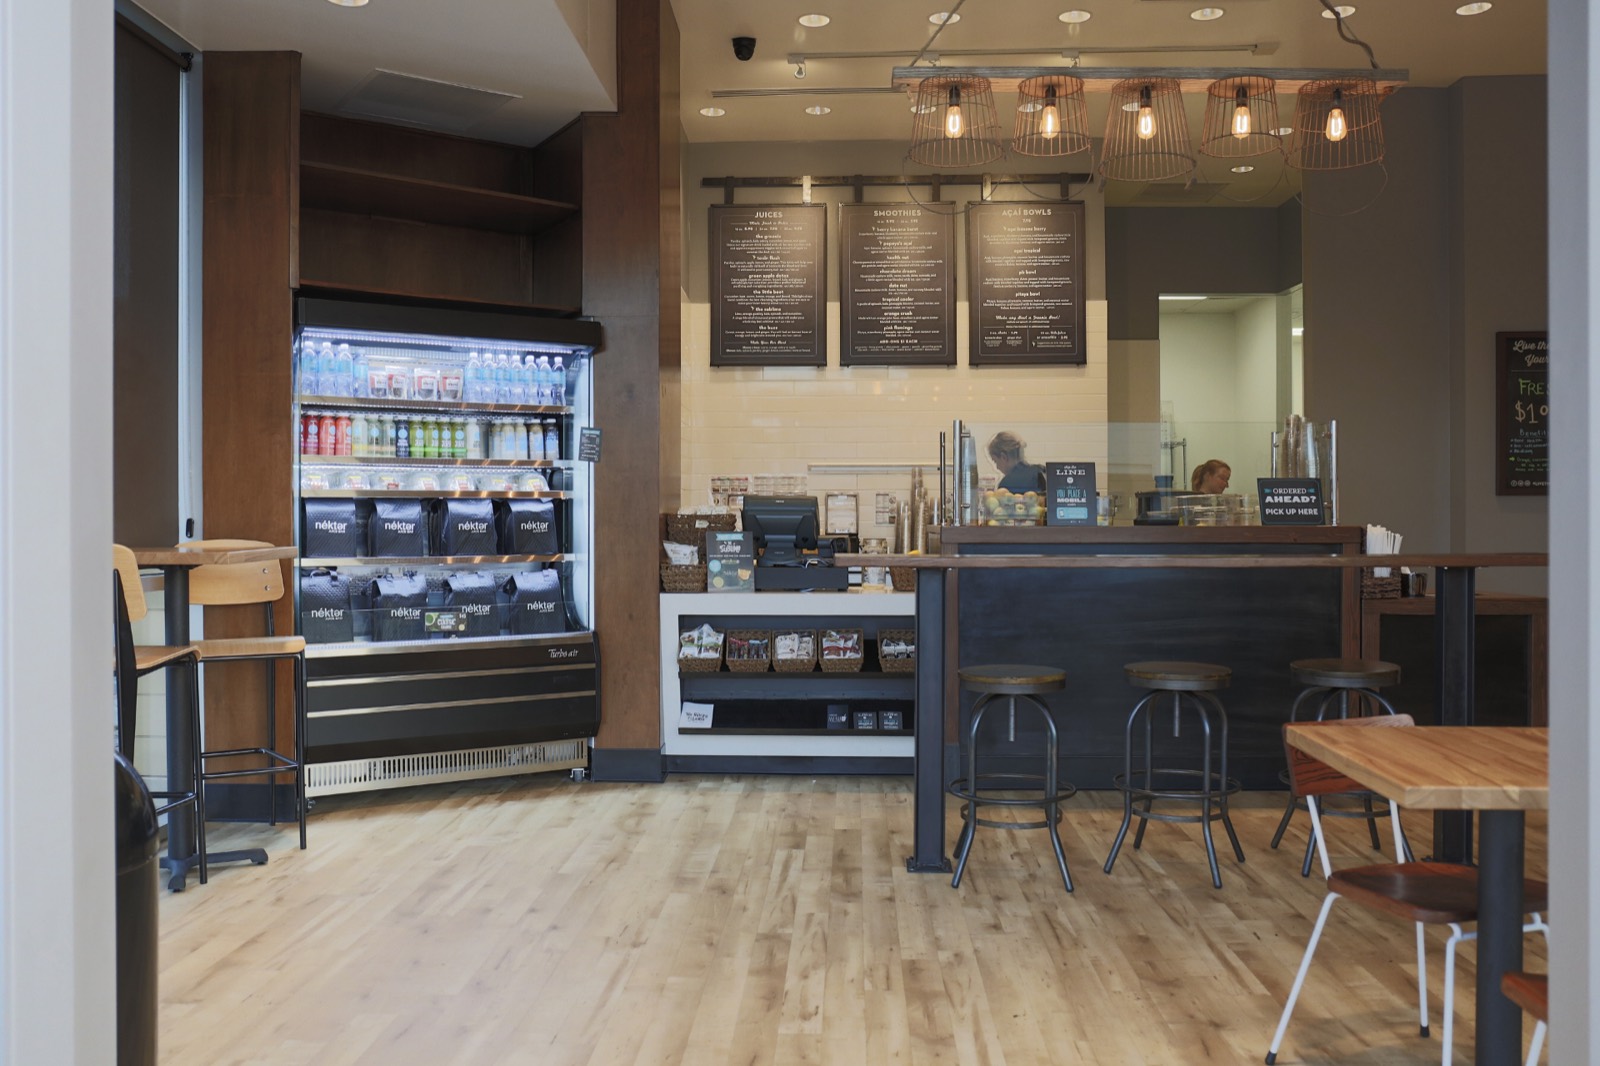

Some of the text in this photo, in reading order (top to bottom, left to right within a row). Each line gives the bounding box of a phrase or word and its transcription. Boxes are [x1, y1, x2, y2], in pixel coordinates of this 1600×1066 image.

[1002, 208, 1021, 218] AÇAÍ
[1513, 340, 1536, 353] Live
[1056, 489, 1065, 498] YOU
[1083, 489, 1086, 498] A
[548, 648, 567, 658] Turbo
